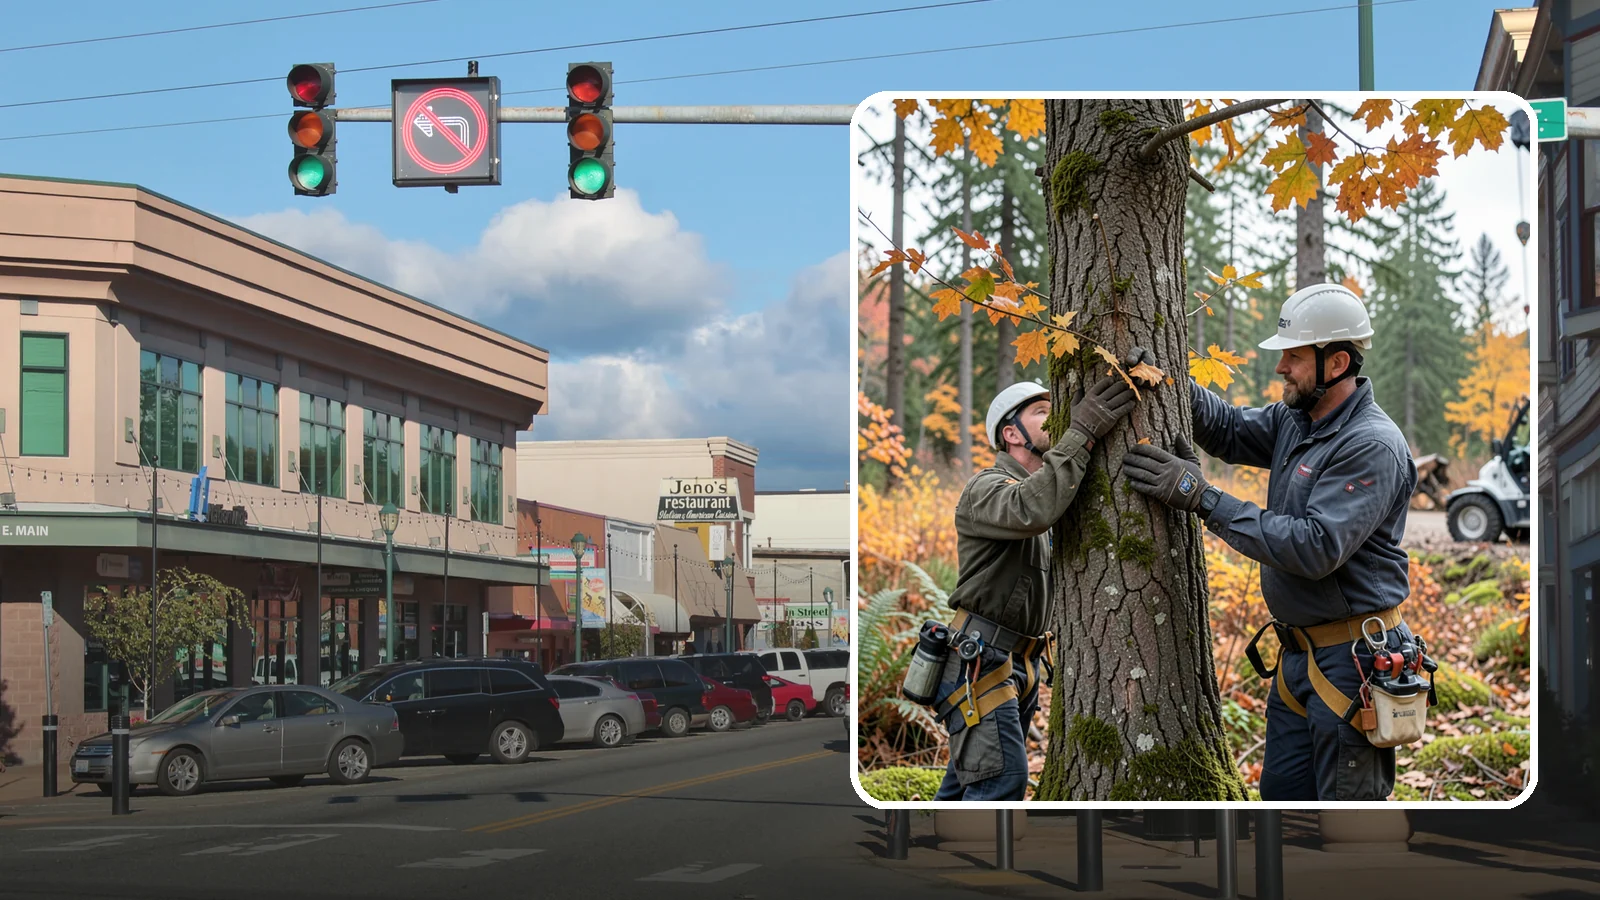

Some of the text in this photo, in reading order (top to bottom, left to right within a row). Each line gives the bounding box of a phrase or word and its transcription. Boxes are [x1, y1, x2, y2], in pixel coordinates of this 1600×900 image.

[669, 480, 728, 495] Jeno's
[665, 496, 731, 509] restaurant
[658, 509, 682, 520] Italian
[686, 509, 714, 520] American
[715, 509, 738, 520] Cuisine
[2, 525, 49, 537] E. MAIN
[797, 607, 828, 617] Street
[790, 619, 824, 627] lass
